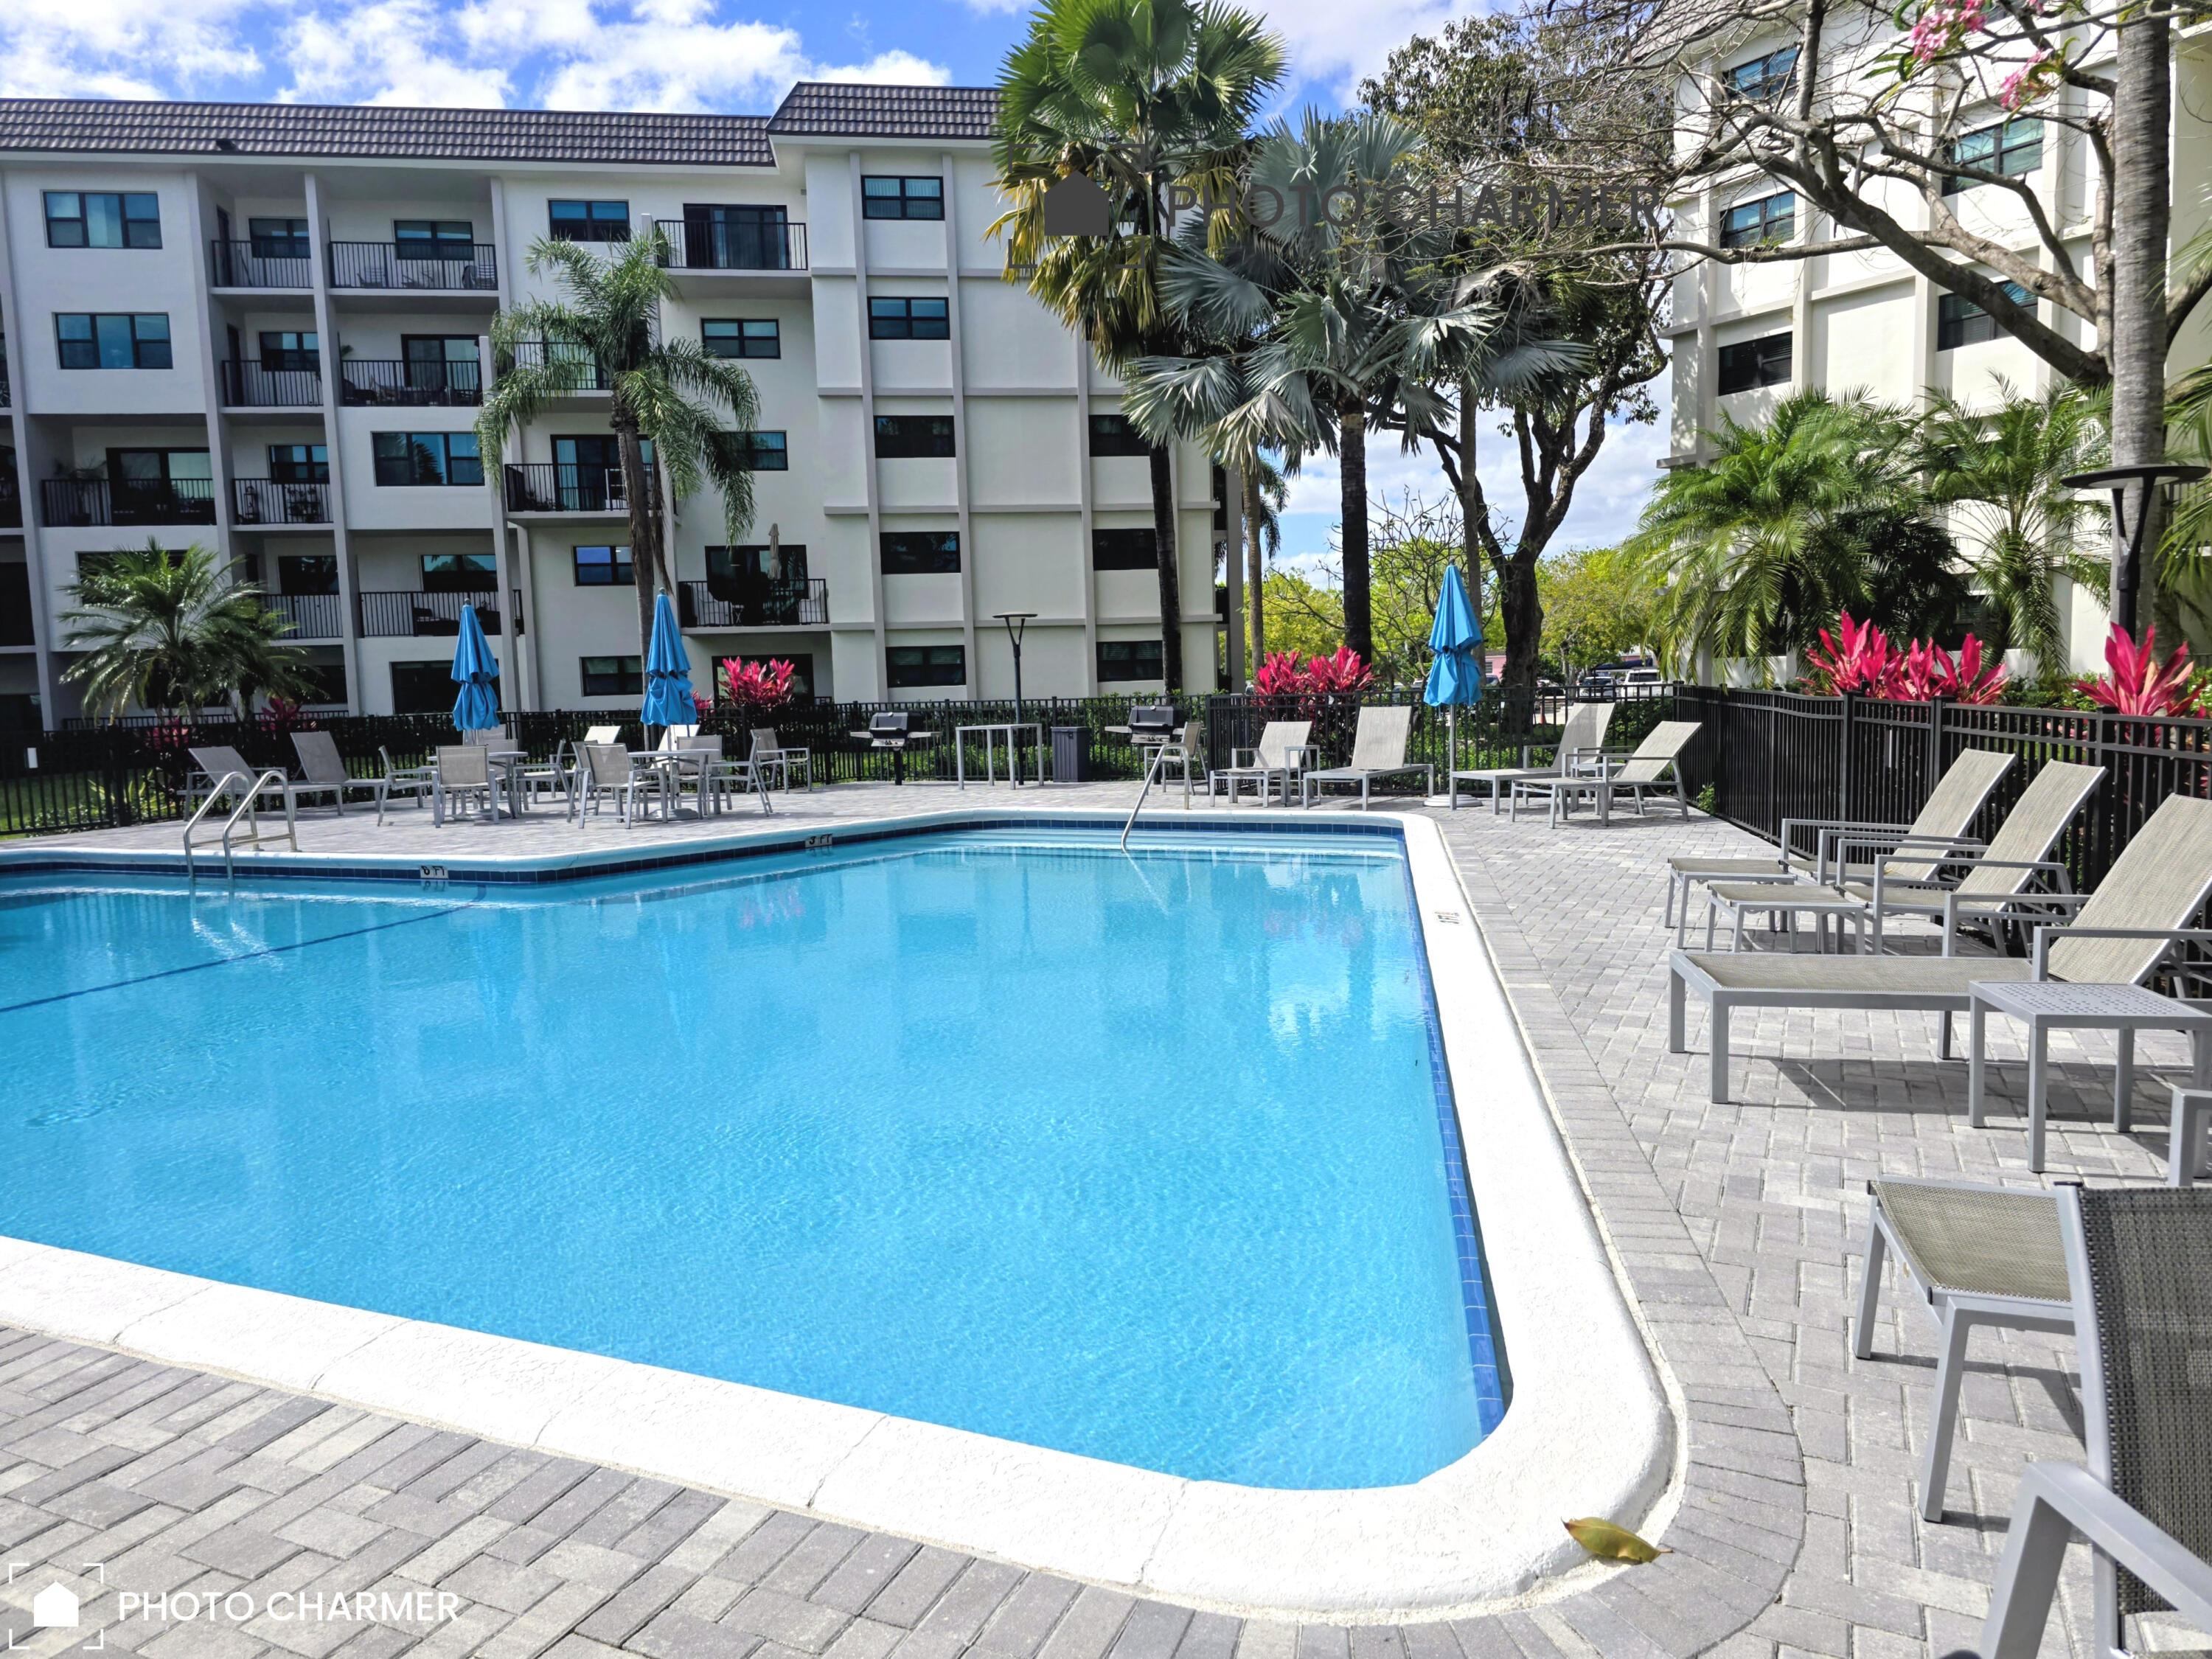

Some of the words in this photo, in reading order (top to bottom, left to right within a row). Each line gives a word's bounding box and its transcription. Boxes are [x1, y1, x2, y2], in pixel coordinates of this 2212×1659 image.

[809, 835, 816, 845] 3
[820, 833, 833, 844] FT
[432, 866, 445, 876] FT
